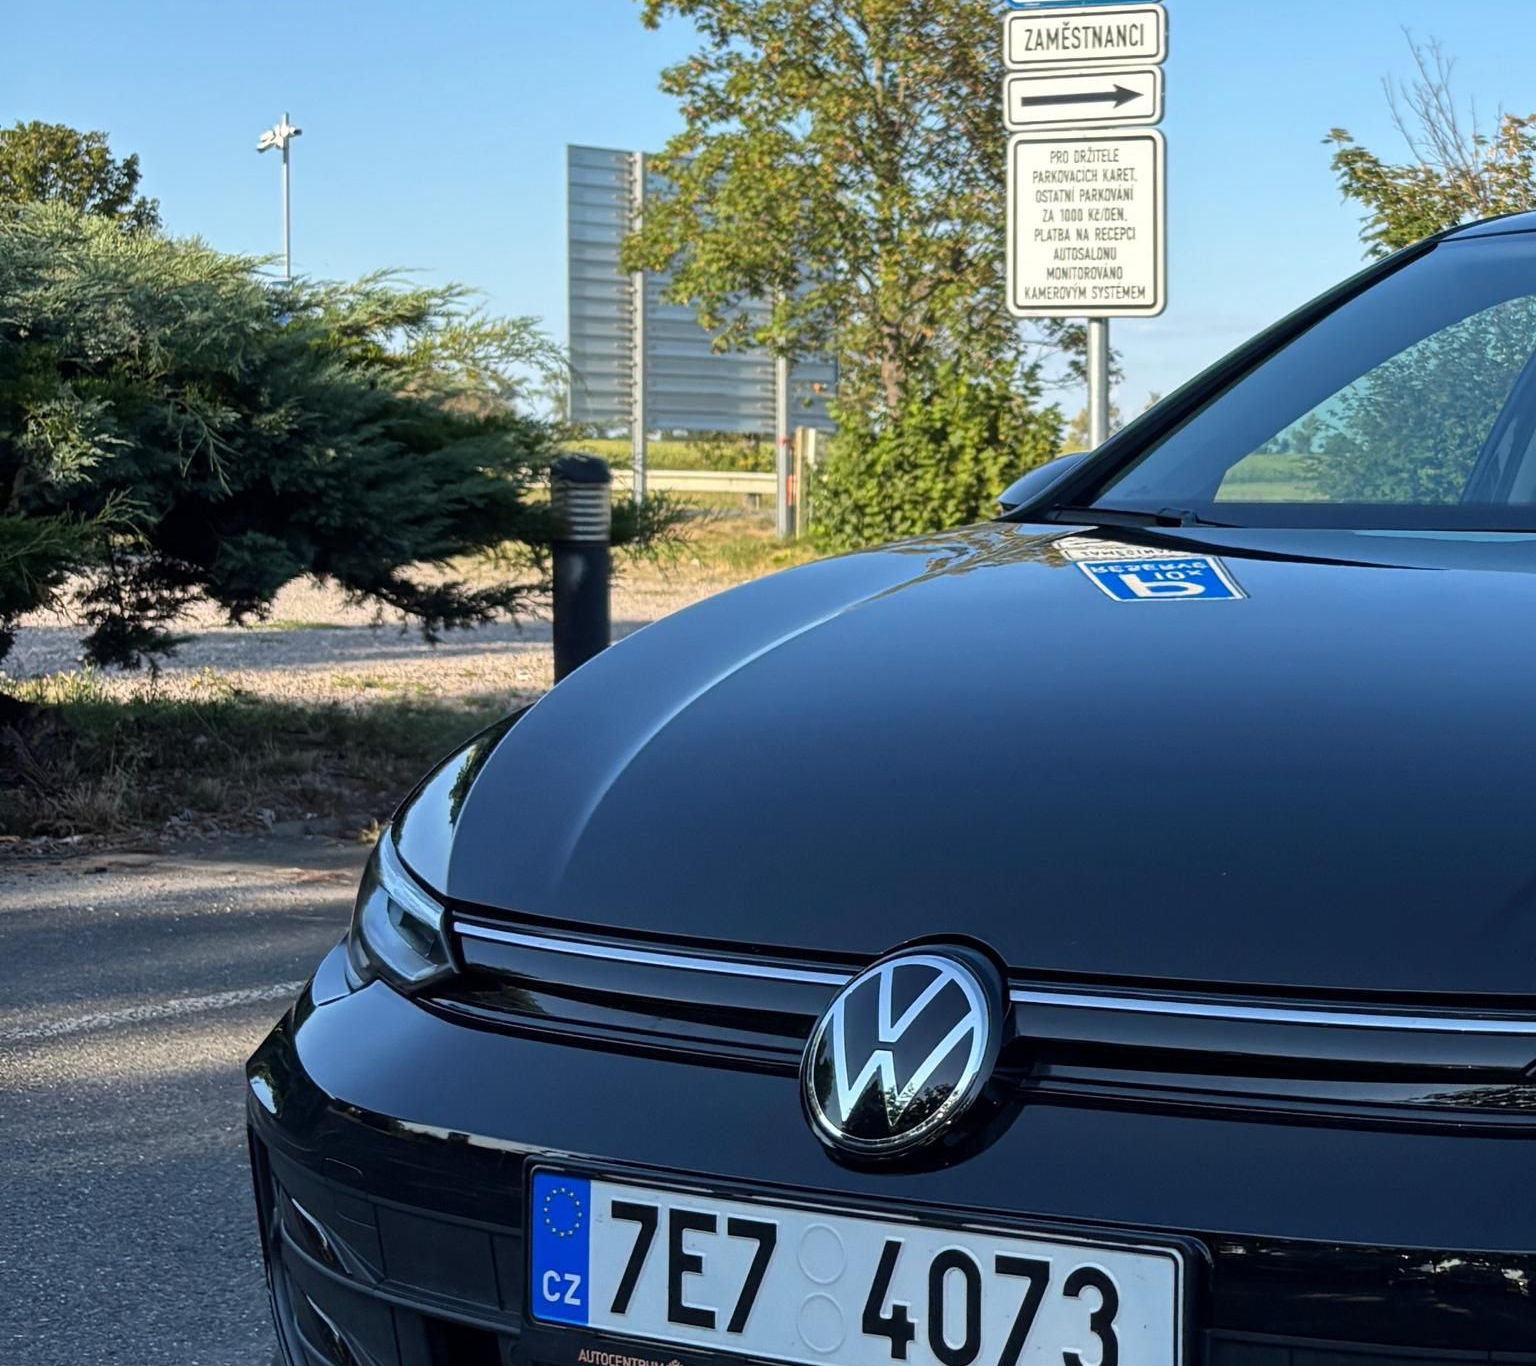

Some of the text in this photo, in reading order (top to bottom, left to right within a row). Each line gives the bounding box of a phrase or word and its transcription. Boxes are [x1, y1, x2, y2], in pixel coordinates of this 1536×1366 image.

[1024, 21, 1144, 51] ZAMĚSTNANCI
[1050, 146, 1120, 164] PRO DRŽITELE
[1032, 166, 1098, 184] PARKOVACÍCH
[1035, 184, 1134, 203] OSTATNÍ PARKOVÁNÍ
[1042, 208, 1055, 223] ZA
[1060, 208, 1083, 222] 1000
[1034, 226, 1136, 242] PLATBA NA RECEPCI
[1053, 246, 1117, 261] AUTOSALONU
[1046, 262, 1123, 281] MONITOROVÁNO
[1024, 281, 1146, 300] KAMEROVÝM SYSTÉMEM
[611, 1199, 778, 1333] 7E7
[542, 1270, 581, 1306] CZ
